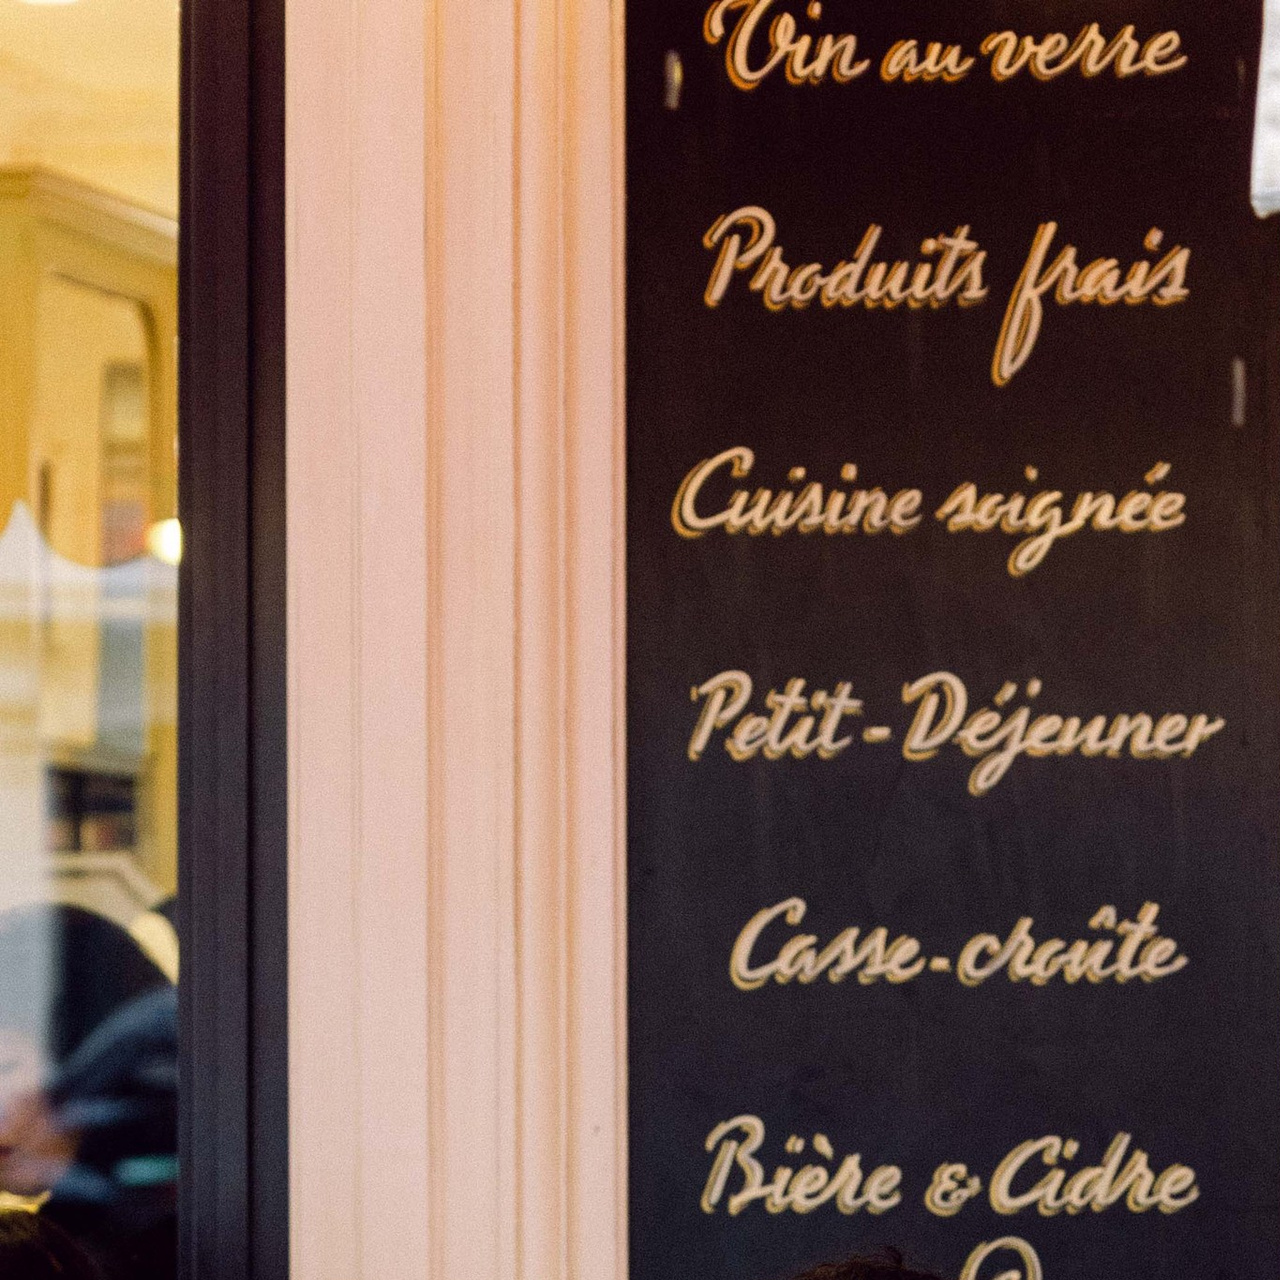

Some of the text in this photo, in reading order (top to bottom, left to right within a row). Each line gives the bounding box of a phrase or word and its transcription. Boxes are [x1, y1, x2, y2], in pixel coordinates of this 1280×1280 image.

[703, 0, 1188, 90] Vin au verre
[702, 205, 1191, 387] Produits frais
[671, 445, 1187, 577] Cuisine soignée
[729, 896, 1189, 990] Casse-croûte
[700, 1114, 1199, 1217] Bière & Cidre
